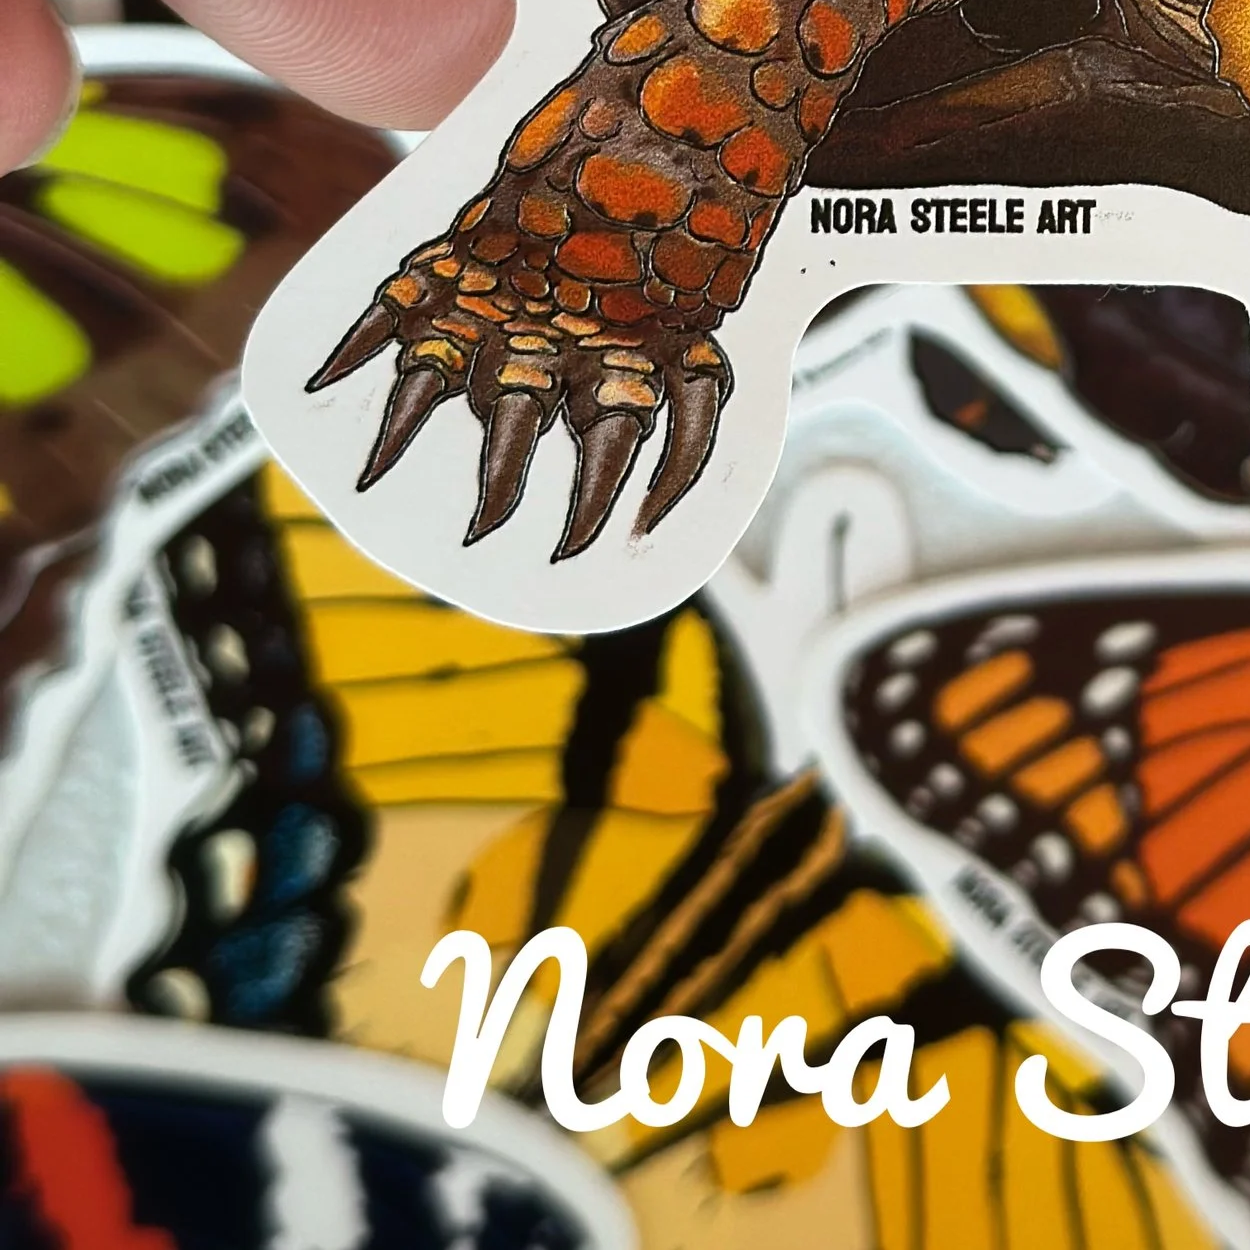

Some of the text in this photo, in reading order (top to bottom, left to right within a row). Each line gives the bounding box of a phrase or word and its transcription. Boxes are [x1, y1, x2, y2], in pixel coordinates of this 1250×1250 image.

[811, 197, 1097, 235] NORA STEELE ART
